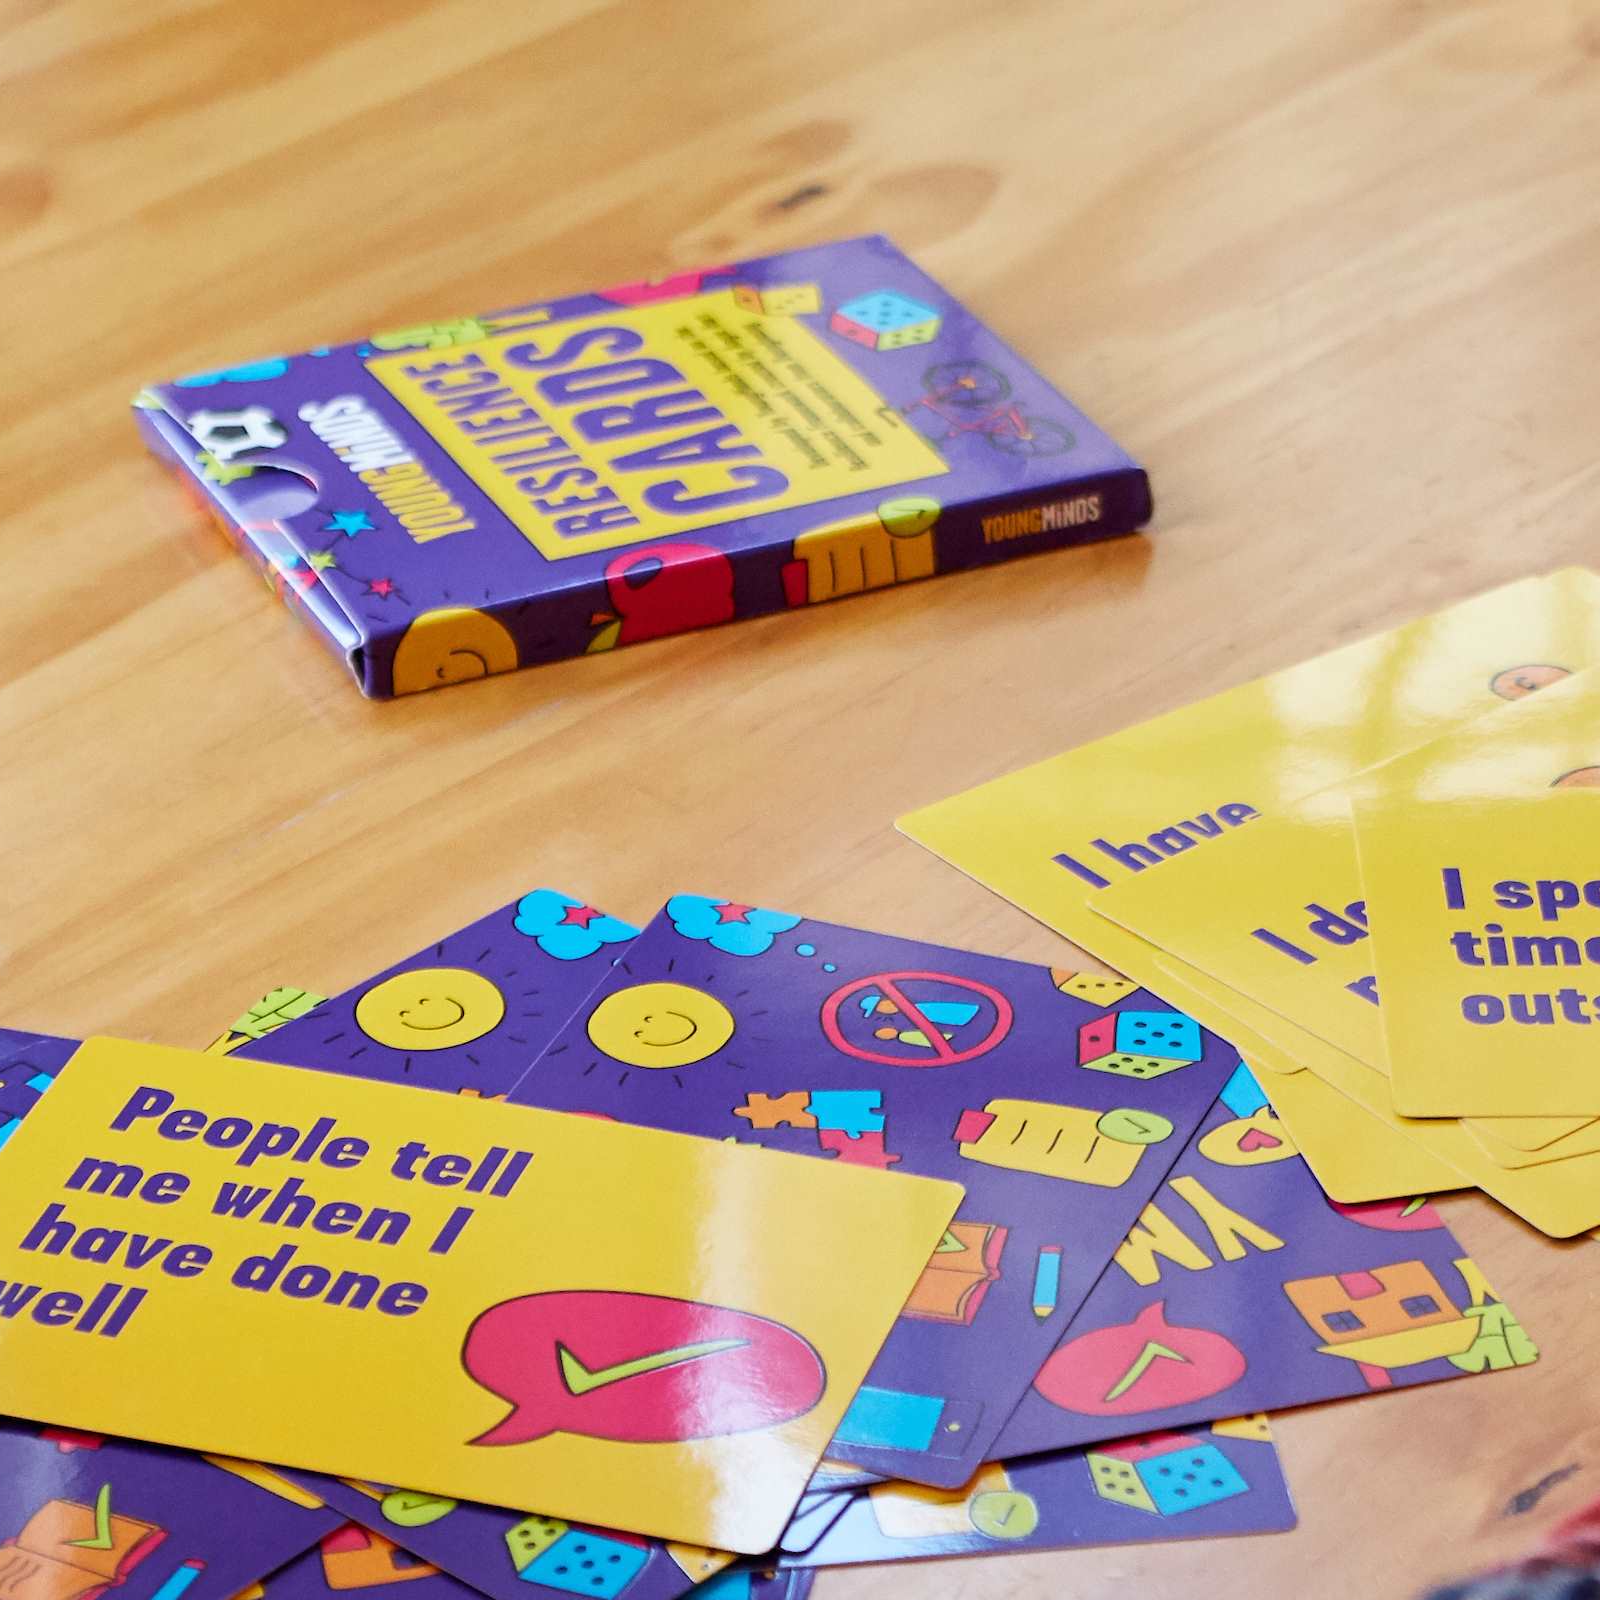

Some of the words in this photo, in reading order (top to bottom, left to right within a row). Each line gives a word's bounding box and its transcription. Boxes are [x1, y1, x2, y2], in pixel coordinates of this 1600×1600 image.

[401, 352, 640, 539] RESILIENCE
[502, 326, 791, 517] CARDS
[1051, 853, 1111, 889] I
[1089, 803, 1262, 873] have
[1441, 867, 1466, 910] I
[1250, 928, 1318, 965] I
[110, 1086, 370, 1168] People
[390, 1140, 533, 1198] tell
[64, 1157, 191, 1204] me
[211, 1178, 411, 1245] when
[429, 1207, 475, 1255] I
[19, 1203, 213, 1278] have
[231, 1244, 429, 1317] done
